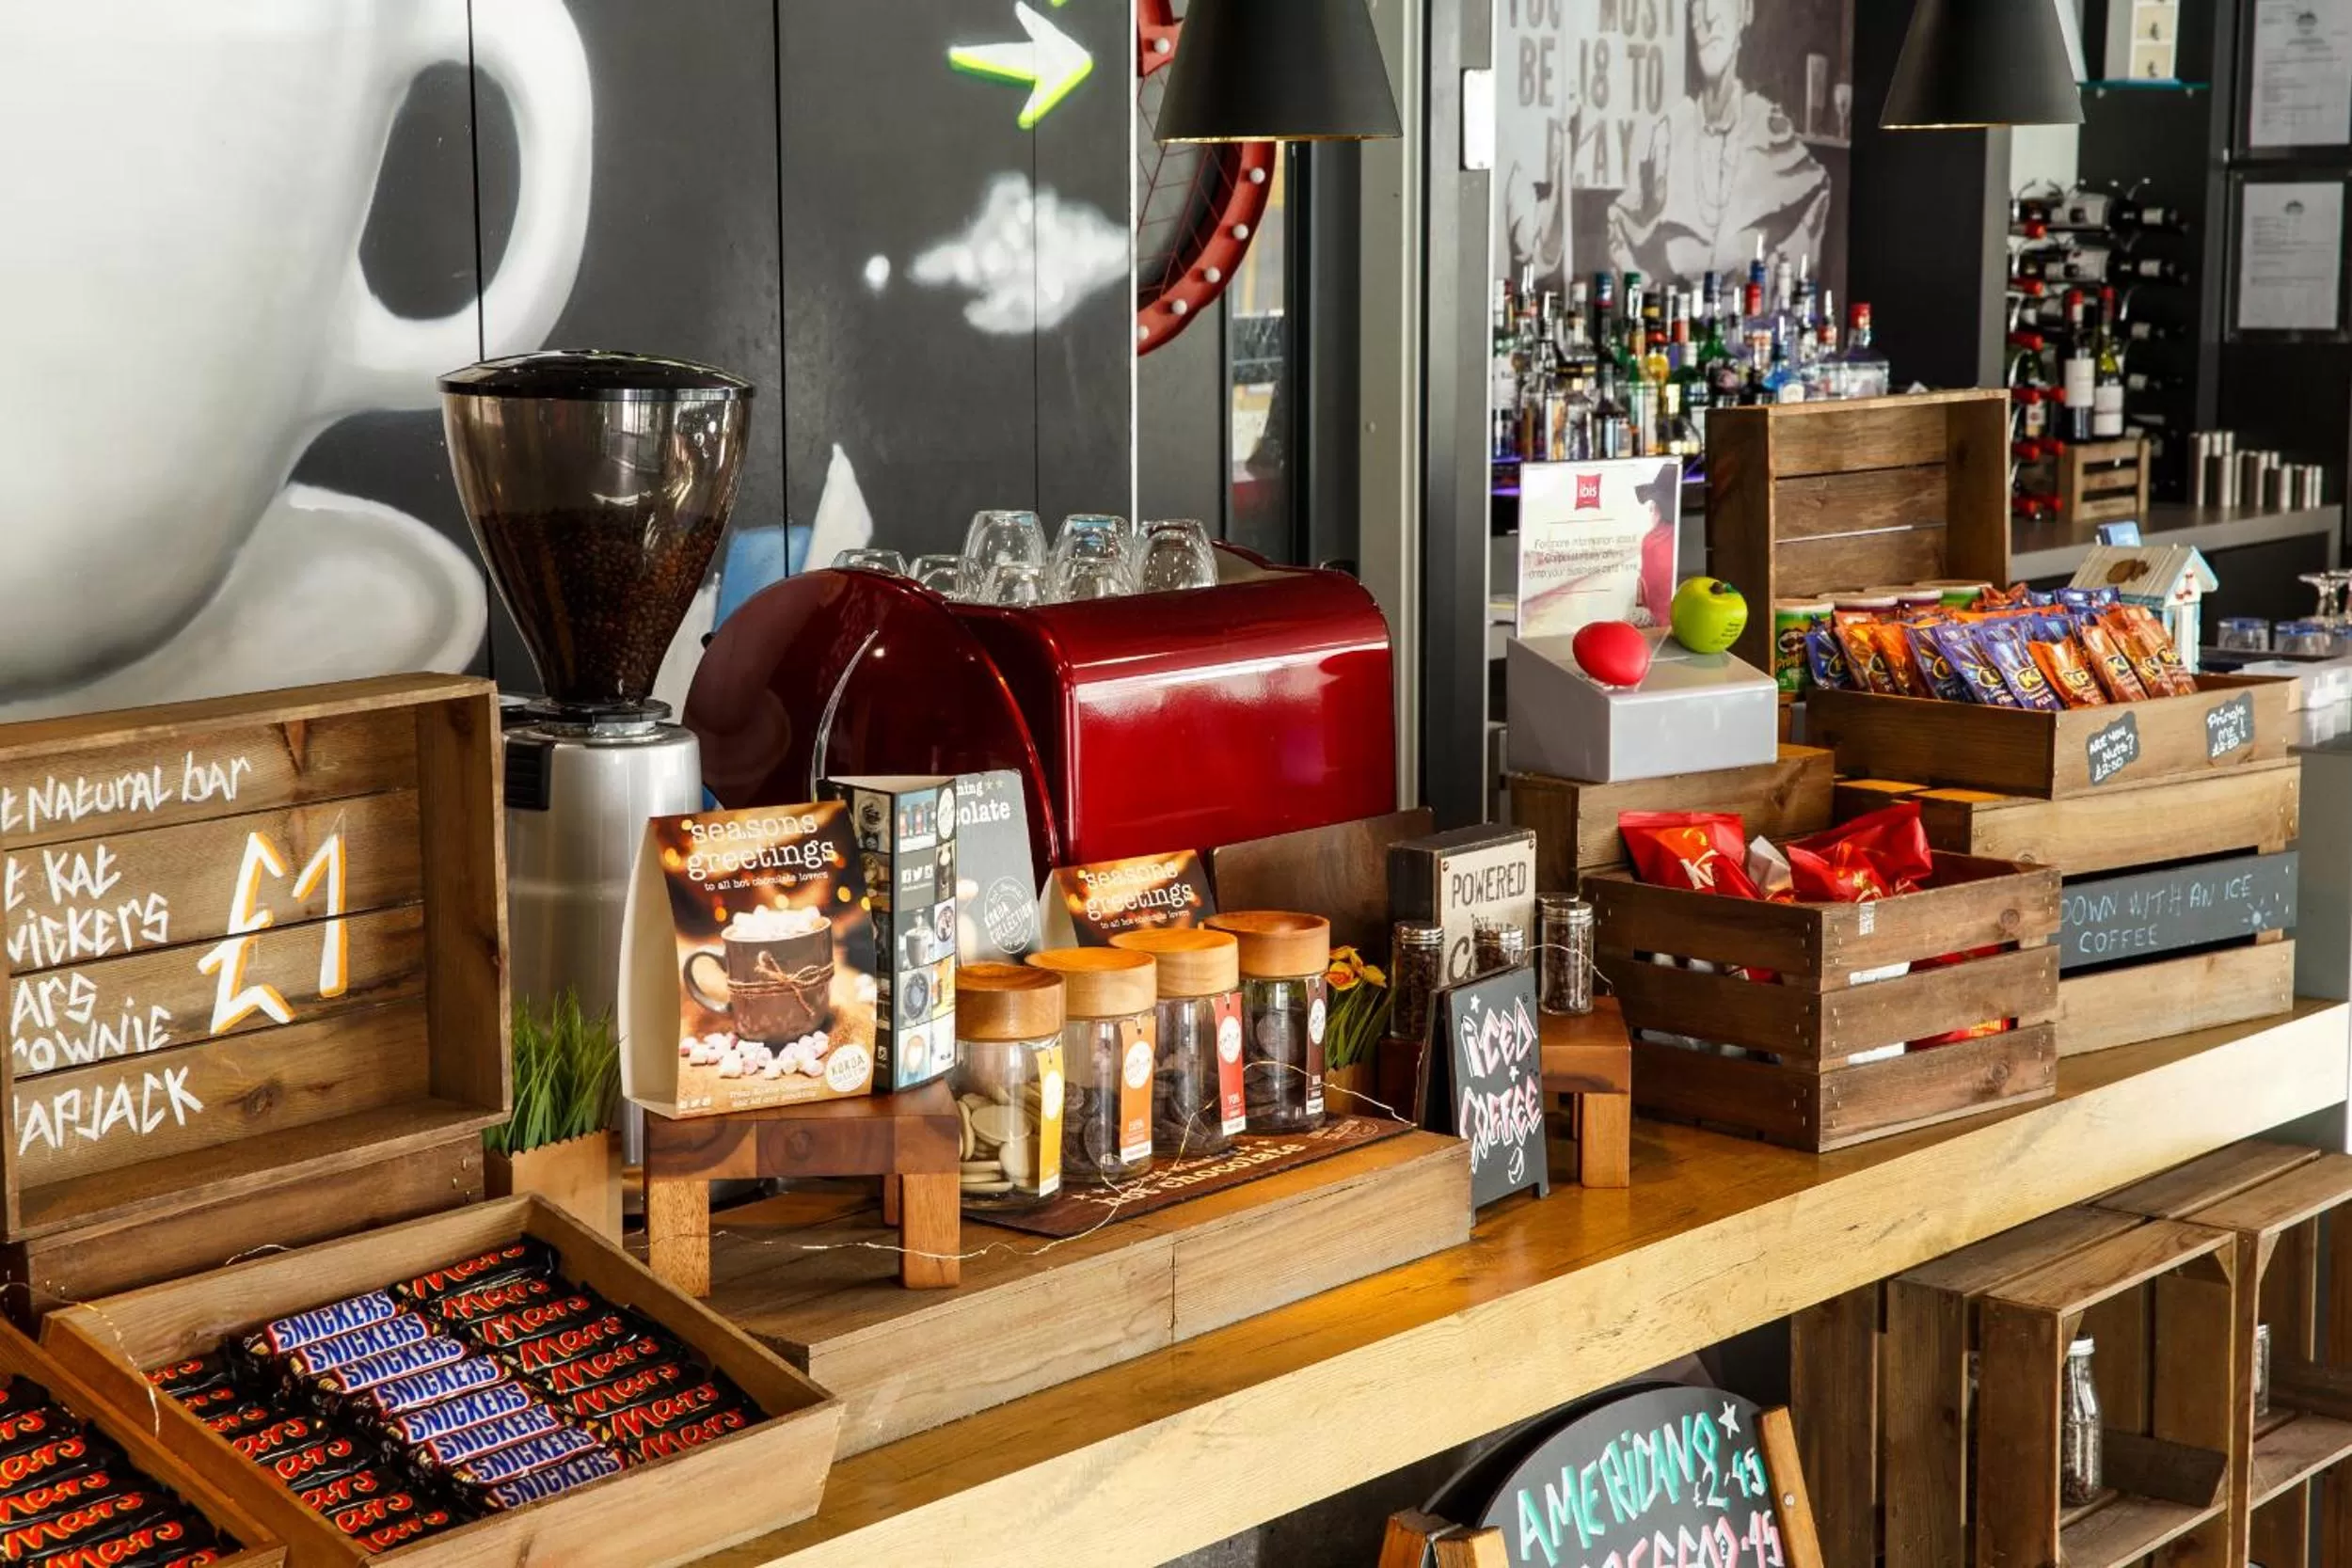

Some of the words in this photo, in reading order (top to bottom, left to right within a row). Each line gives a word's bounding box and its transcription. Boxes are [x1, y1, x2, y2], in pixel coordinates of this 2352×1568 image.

[1518, 36, 1555, 107] BE
[1580, 38, 1611, 110] 18
[1627, 44, 1664, 116] TO
[1580, 482, 1597, 498] ibis
[2090, 735, 2108, 755] ARE
[691, 815, 818, 845] seasons
[687, 839, 839, 881] greetings
[1085, 861, 1179, 890] seasons
[1452, 860, 1527, 909] POWERED
[704, 882, 716, 892] to
[718, 880, 731, 890] all
[1086, 882, 1196, 921] greetings
[2129, 880, 2183, 921] WITH
[2190, 881, 2216, 909] AN
[2224, 874, 2253, 901] ICE
[197, 830, 349, 1035] £1
[2079, 923, 2159, 954] COFFEE
[1158, 1143, 1307, 1190] chocolate
[273, 1290, 394, 1349] SNICKERS
[442, 1279, 550, 1320] Mars
[482, 1294, 591, 1346] Mars
[303, 1316, 426, 1373] SNICKERS
[340, 1335, 464, 1388] SNICKERS
[518, 1316, 625, 1373] Mars
[551, 1336, 660, 1395] Mars
[377, 1354, 498, 1408] SNICKERS
[572, 1362, 680, 1416] Mars
[405, 1384, 528, 1440] SNICKERS
[435, 1403, 557, 1461] SNICKERS
[612, 1381, 720, 1441] Mars
[640, 1408, 746, 1461] Mars
[231, 1417, 309, 1459] ars
[267, 1436, 352, 1484] ars
[469, 1425, 594, 1481] SNICKERS
[299, 1469, 379, 1513] ars
[496, 1451, 621, 1509] SNICKERS
[4, 1492, 144, 1561] Mars
[334, 1491, 413, 1535] ars
[45, 1520, 183, 1568] Mars
